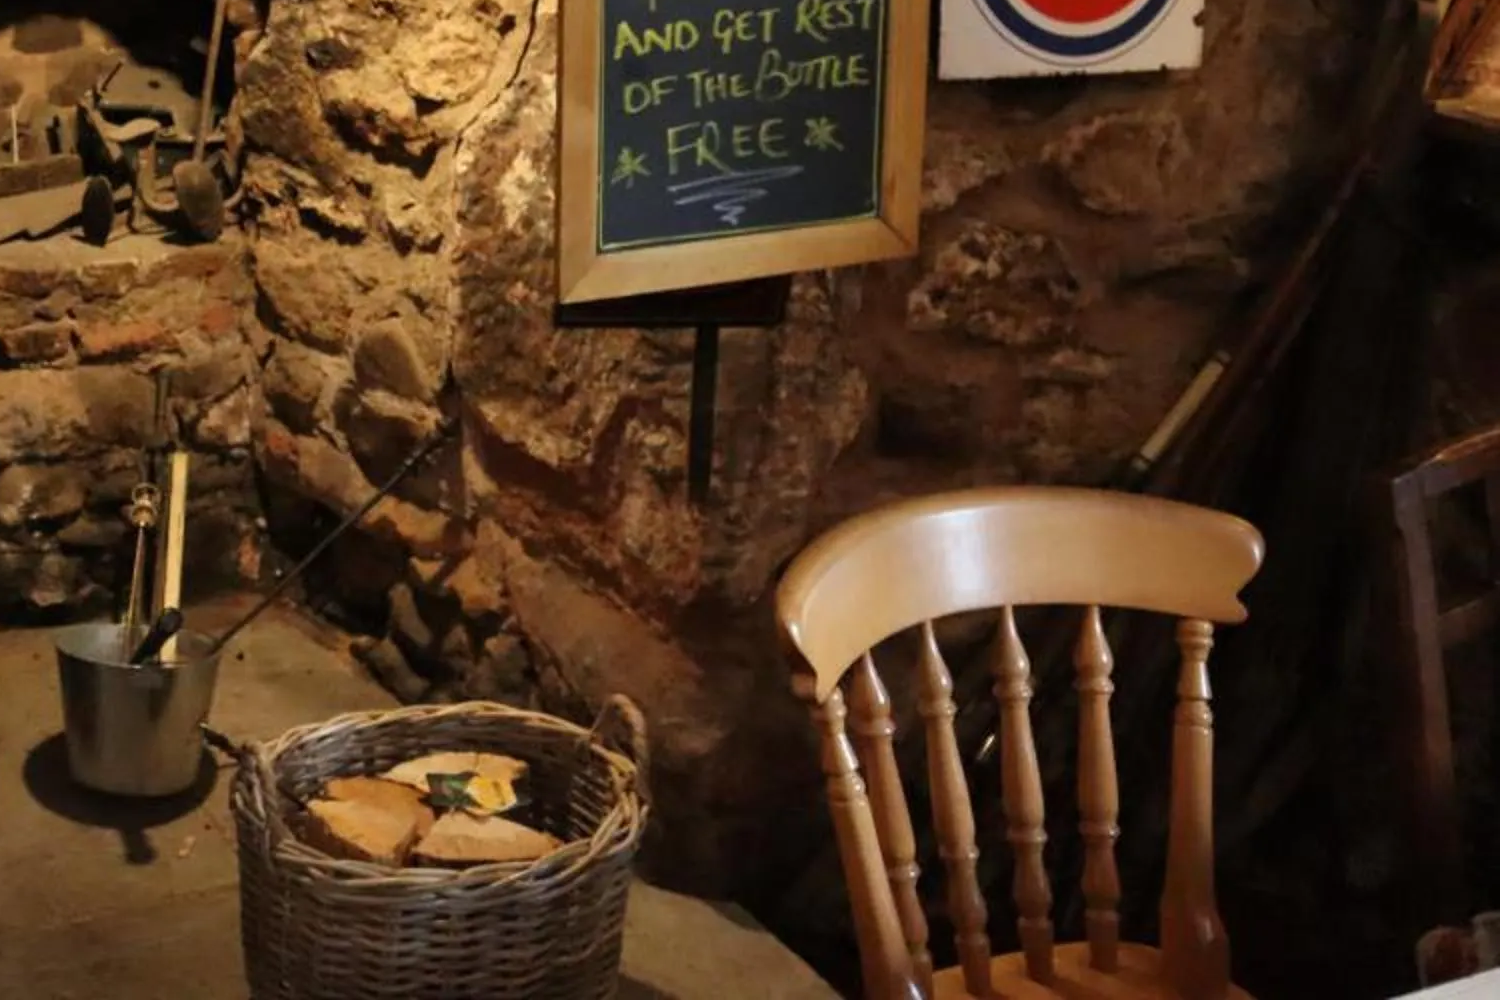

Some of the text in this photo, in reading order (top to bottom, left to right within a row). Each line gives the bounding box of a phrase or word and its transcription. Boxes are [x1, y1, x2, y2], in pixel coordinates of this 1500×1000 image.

[613, 20, 699, 60] AND
[713, 8, 781, 54] GET
[623, 48, 871, 115] OF THE BOTTLE
[667, 117, 790, 176] FREE
